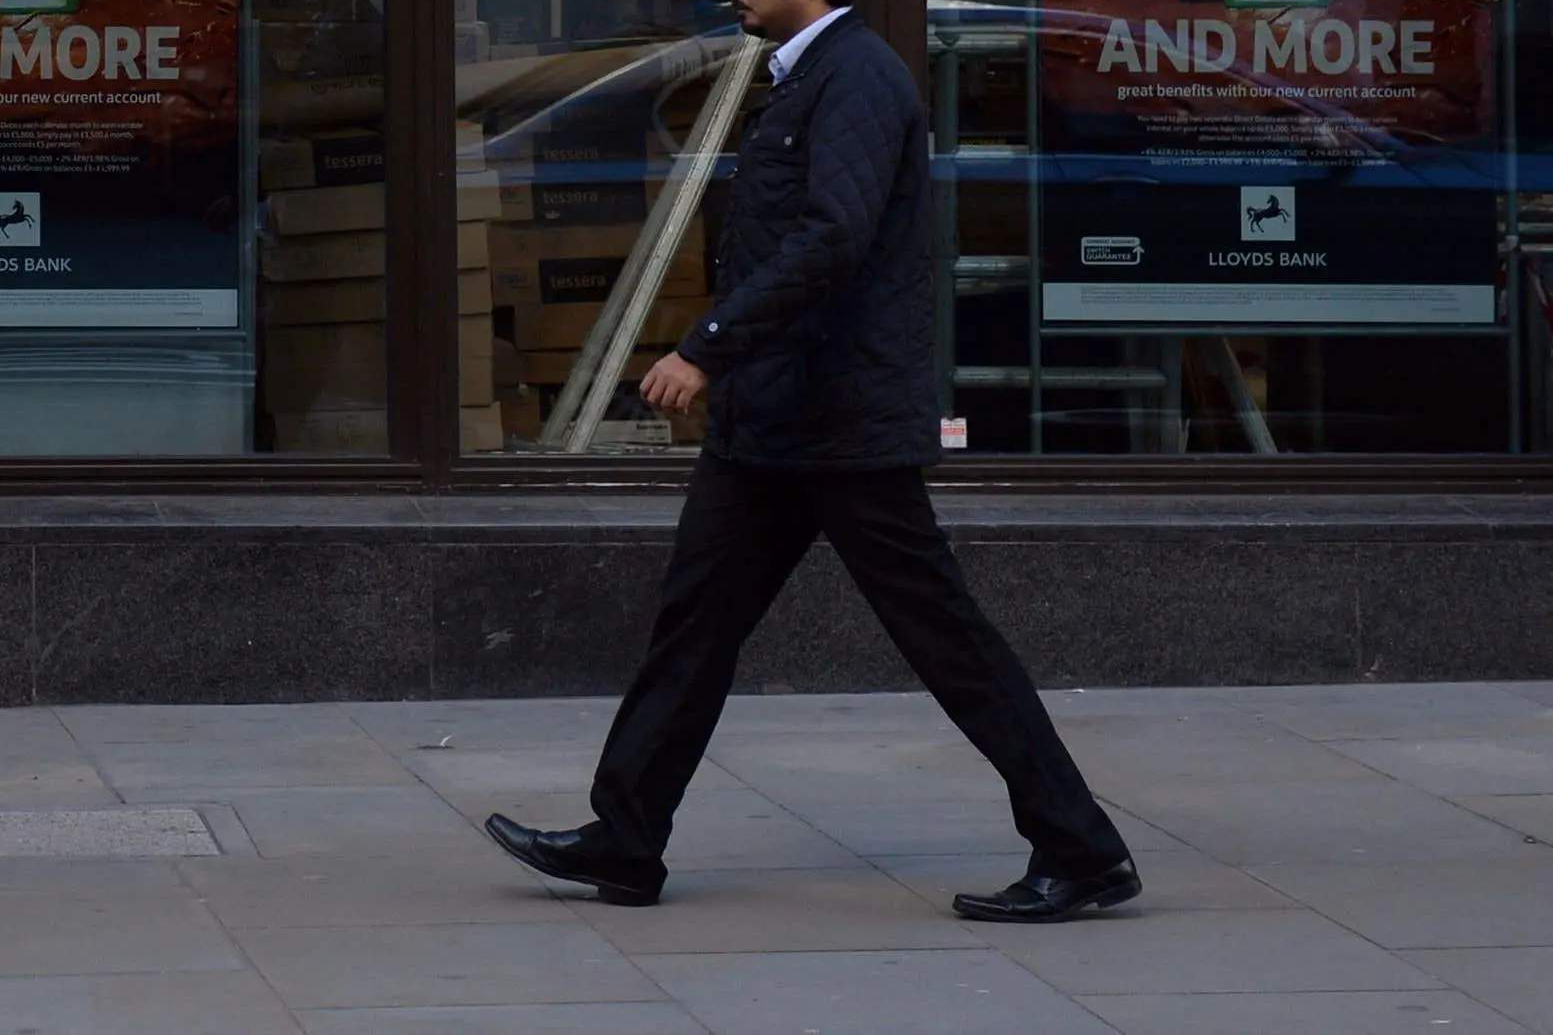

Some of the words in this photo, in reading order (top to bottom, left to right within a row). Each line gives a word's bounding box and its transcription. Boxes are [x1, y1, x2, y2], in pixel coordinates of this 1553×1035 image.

[0, 26, 181, 81] MORE
[1097, 18, 1237, 74] AND
[1252, 18, 1435, 74] MORE
[21, 93, 51, 104] new
[53, 92, 103, 104] current
[106, 92, 161, 104] account
[1117, 85, 1154, 101] great
[1156, 83, 1214, 98] benefits
[1216, 83, 1247, 97] with
[1249, 86, 1273, 98] our
[1276, 86, 1305, 98] new
[1307, 85, 1358, 99] current
[1360, 85, 1416, 99] account
[323, 153, 383, 170] tessera
[24, 257, 72, 272] BANK
[1209, 252, 1274, 267] LLOYDS
[1279, 252, 1327, 267] BANK
[550, 273, 607, 289] tessera
